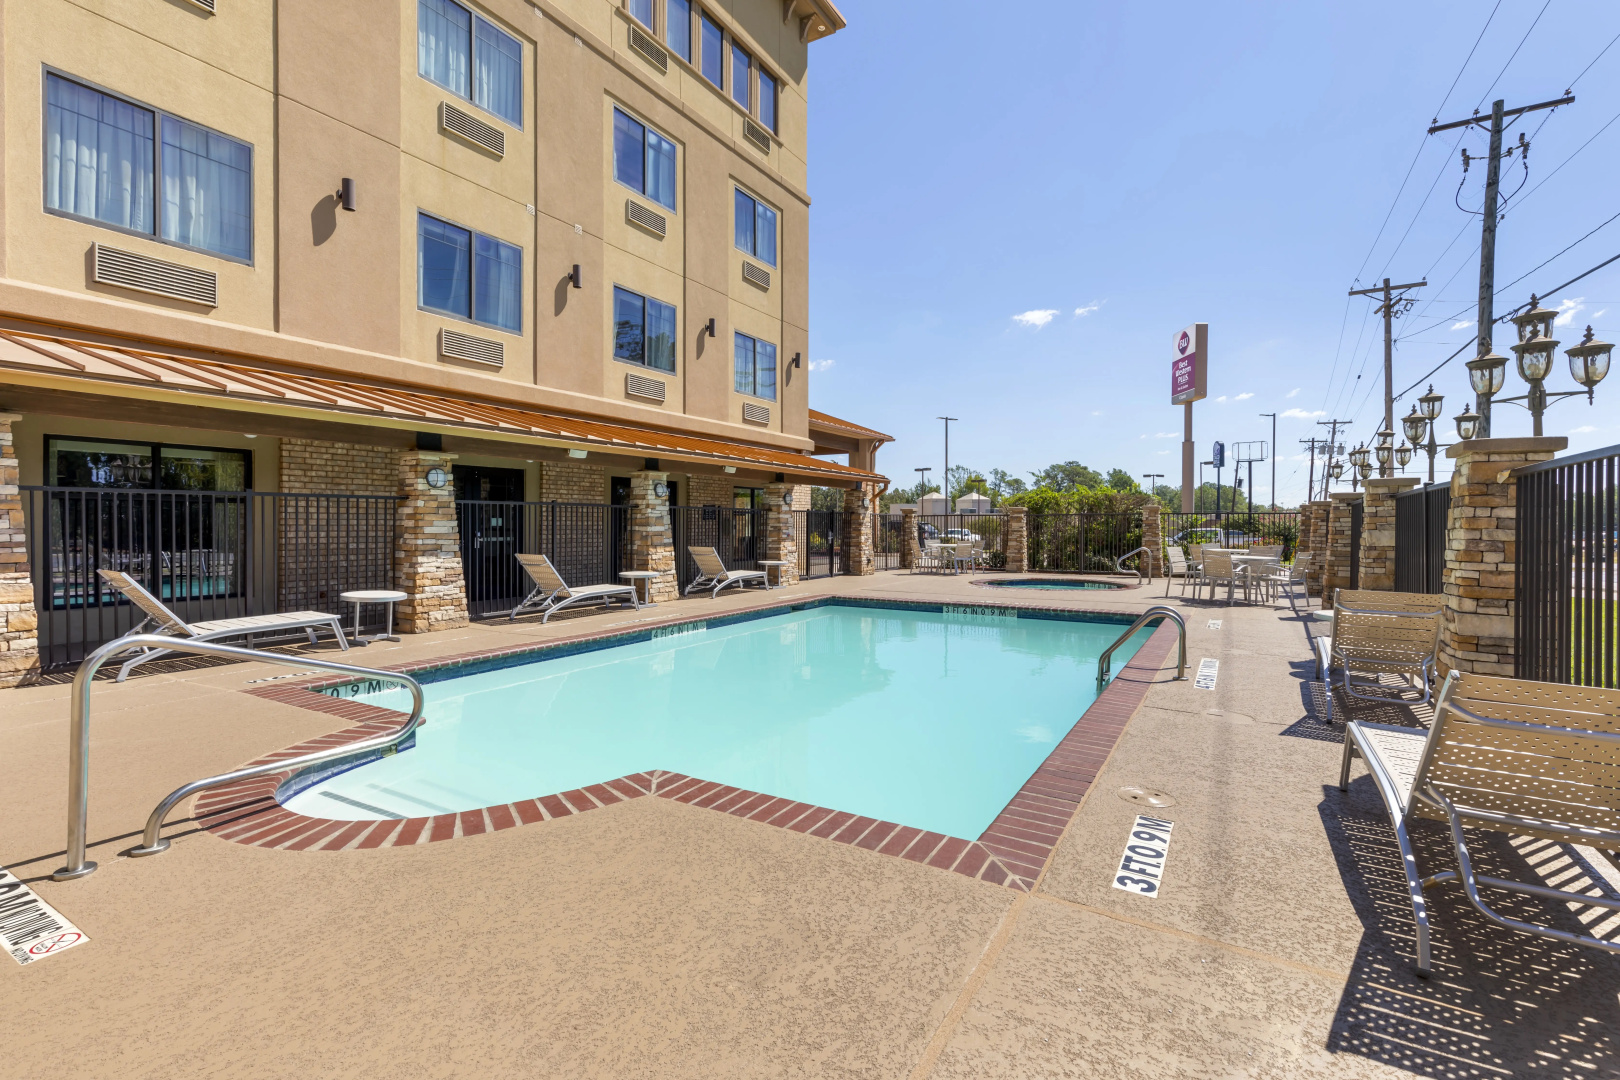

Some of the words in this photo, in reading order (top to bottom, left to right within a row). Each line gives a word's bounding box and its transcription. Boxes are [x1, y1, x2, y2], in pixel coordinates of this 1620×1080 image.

[1178, 360, 1188, 369] Best
[1175, 366, 1191, 378] Western
[1177, 374, 1189, 384] PLUS
